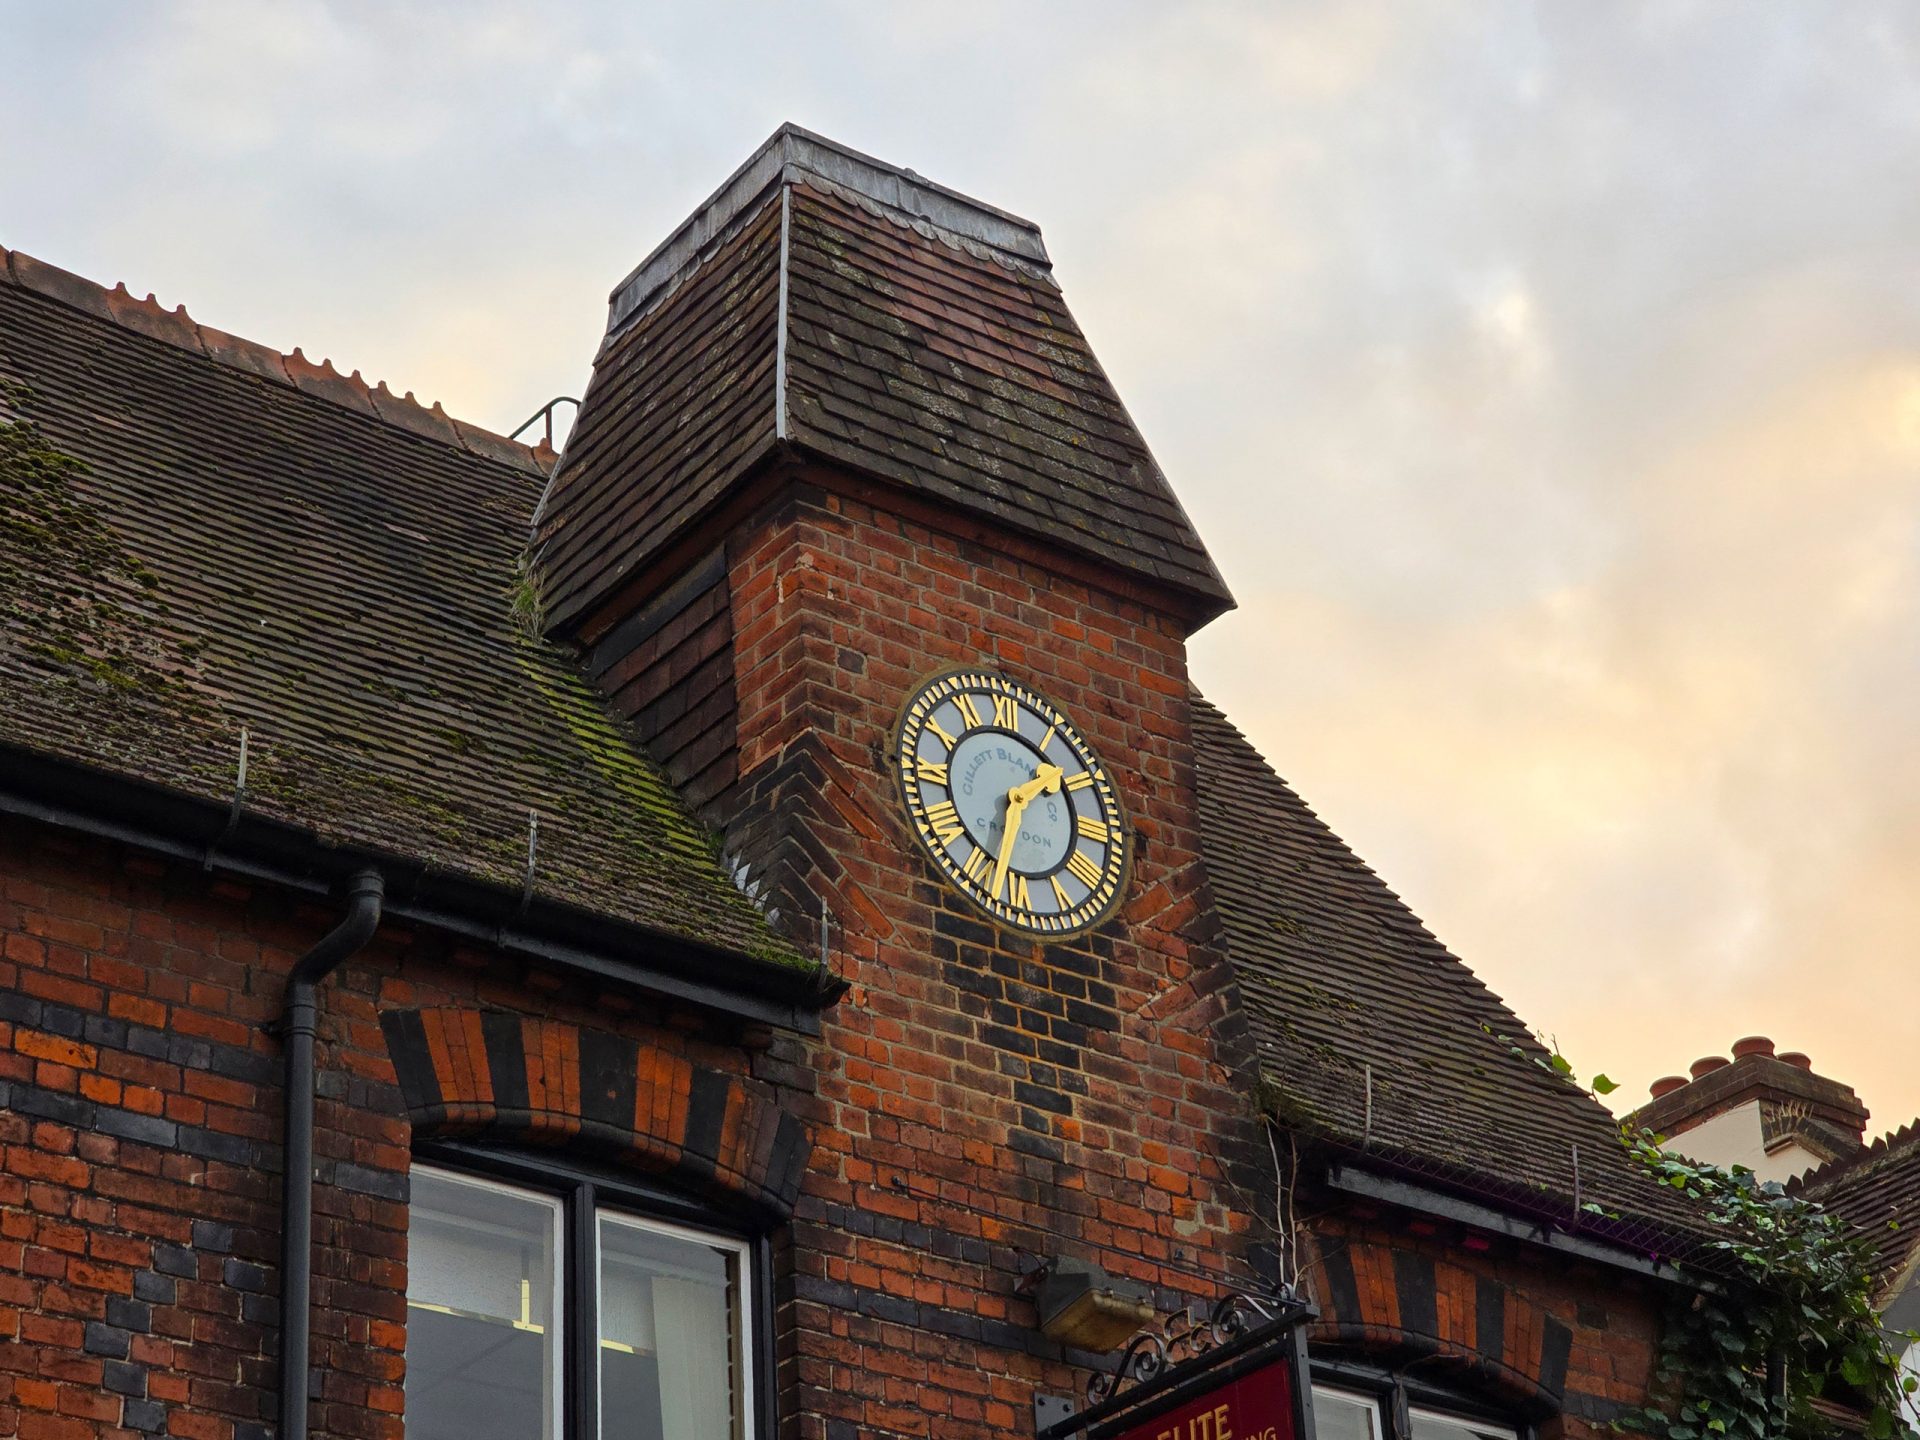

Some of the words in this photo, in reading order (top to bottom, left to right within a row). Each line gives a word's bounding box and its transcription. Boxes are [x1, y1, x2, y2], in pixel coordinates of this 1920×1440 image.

[952, 693, 983, 730] XI
[992, 693, 1018, 732] XII
[925, 715, 957, 751] X
[917, 756, 948, 785] IX
[962, 749, 993, 796] GILLETT
[1064, 770, 1094, 792] II
[925, 800, 965, 846] VIII
[976, 817, 1052, 848] CRODON
[1077, 815, 1108, 843] III
[1009, 871, 1032, 911] VI
[1050, 875, 1075, 911] V
